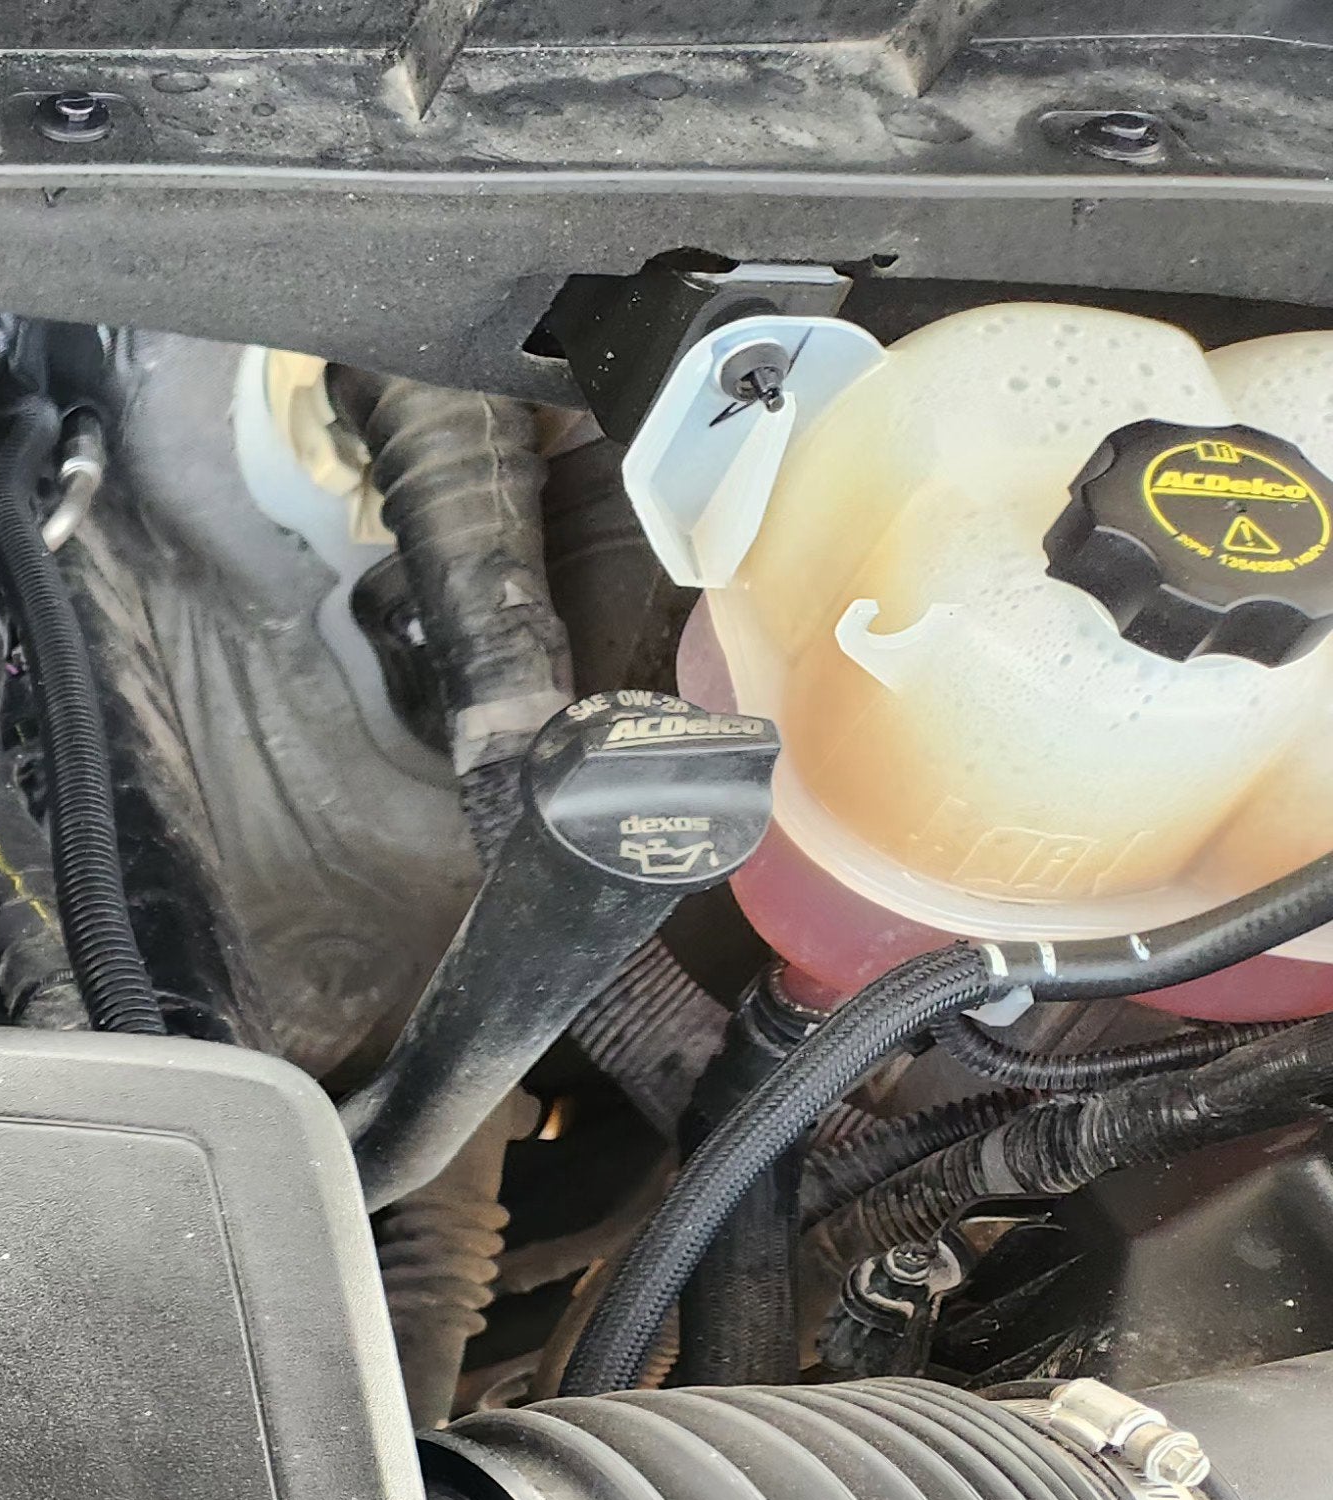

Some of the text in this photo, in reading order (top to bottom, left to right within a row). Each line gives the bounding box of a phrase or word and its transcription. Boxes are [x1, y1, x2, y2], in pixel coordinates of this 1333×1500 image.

[1154, 470, 1308, 499] ACDelco
[566, 693, 612, 721] SAE
[604, 714, 765, 742] ACDelco
[619, 815, 712, 835] dexos
